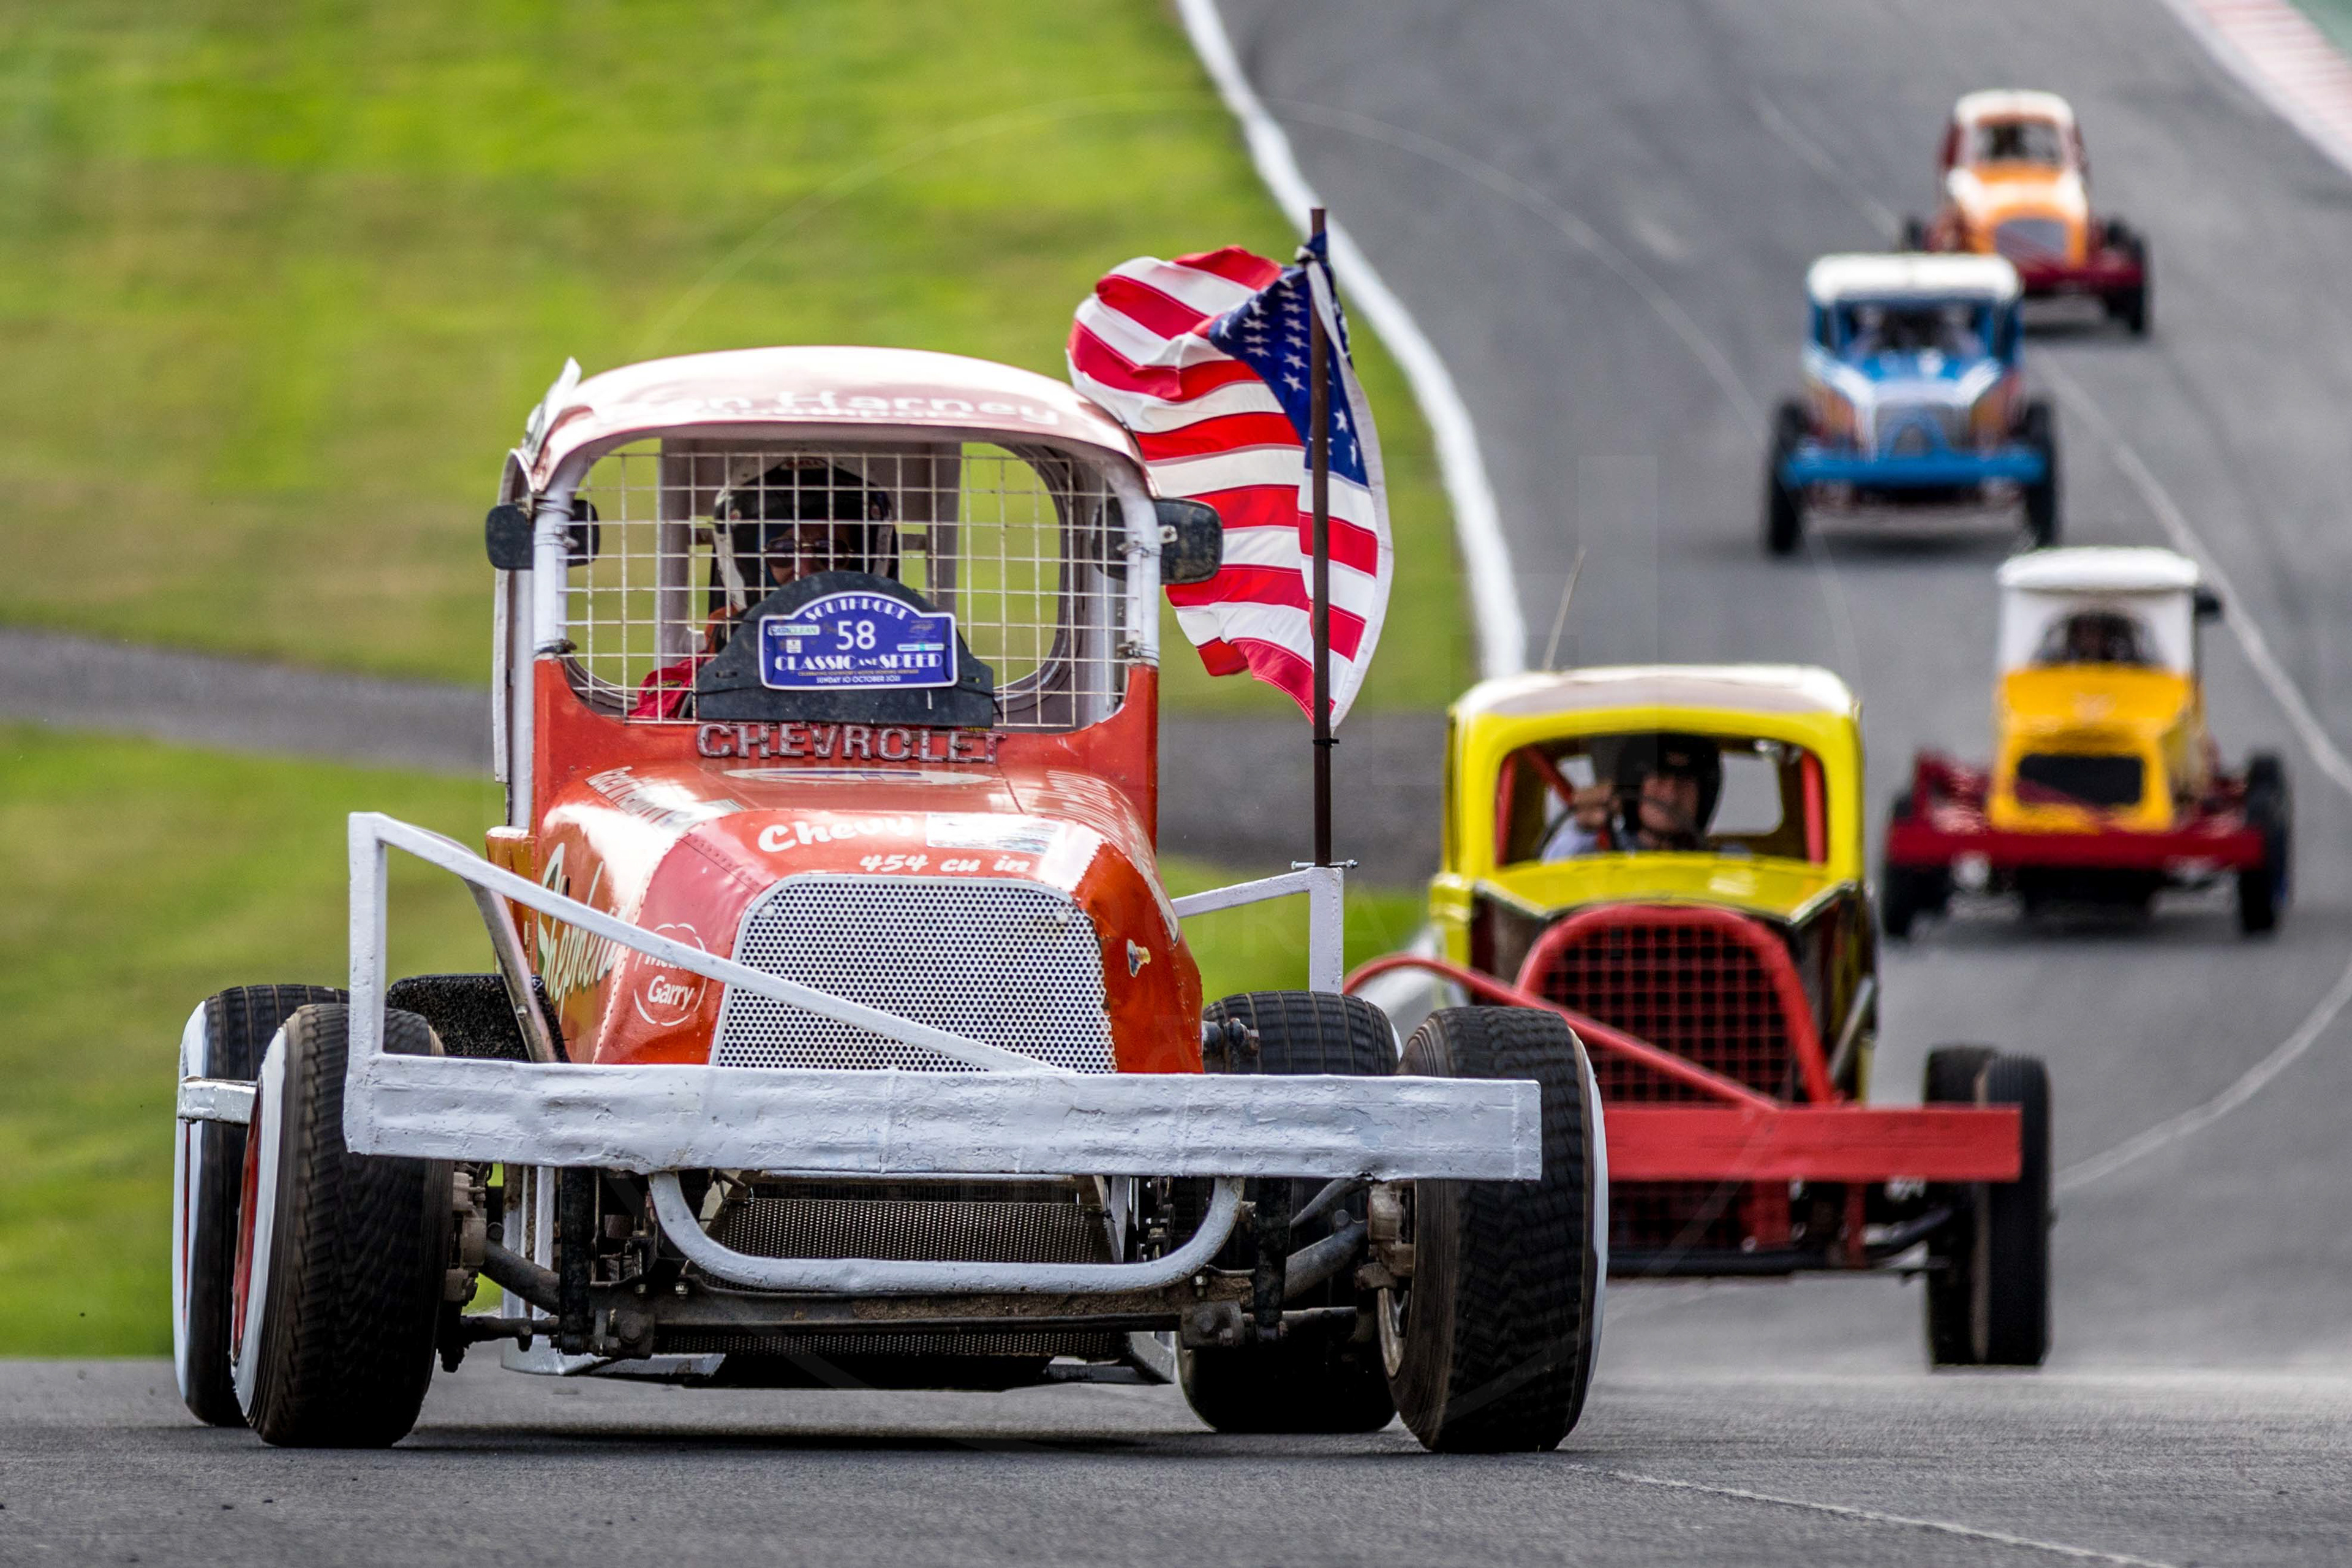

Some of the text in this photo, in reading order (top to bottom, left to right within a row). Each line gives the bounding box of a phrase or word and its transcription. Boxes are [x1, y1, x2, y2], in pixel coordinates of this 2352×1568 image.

[777, 390, 1060, 425] Harney
[805, 597, 909, 621] SOUTHPORT
[835, 620, 876, 650] 58
[774, 654, 857, 671] CLASSIC
[878, 653, 943, 669] SPEED
[696, 722, 1007, 764] CHEVROLET
[757, 816, 916, 853] Chevy
[859, 853, 1031, 872] 454 cu in
[647, 974, 695, 1011] Garry
